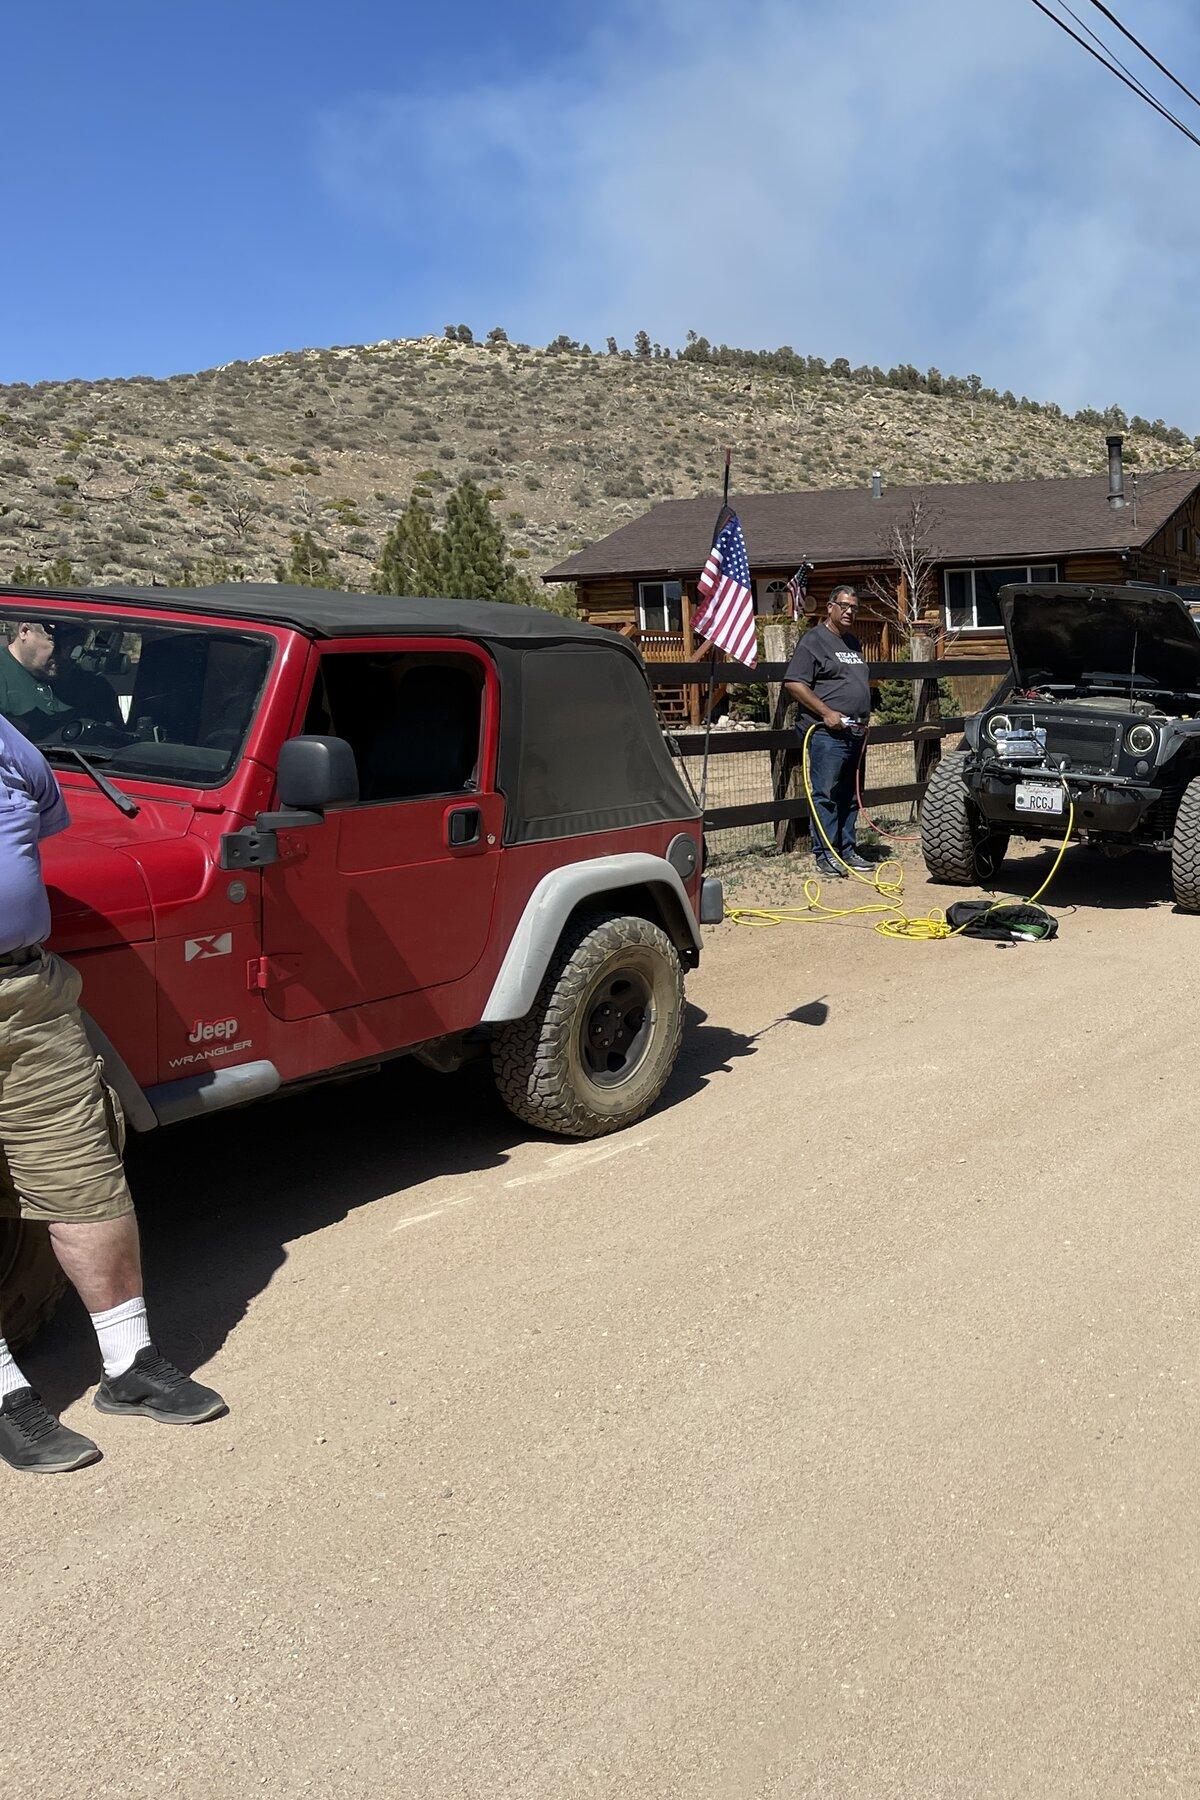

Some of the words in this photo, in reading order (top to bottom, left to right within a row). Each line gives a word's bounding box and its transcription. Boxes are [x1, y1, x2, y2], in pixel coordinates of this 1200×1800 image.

[1030, 795, 1054, 810] RCGJ
[189, 1019, 239, 1042] Jeep
[169, 1039, 253, 1068] WRANGLER
